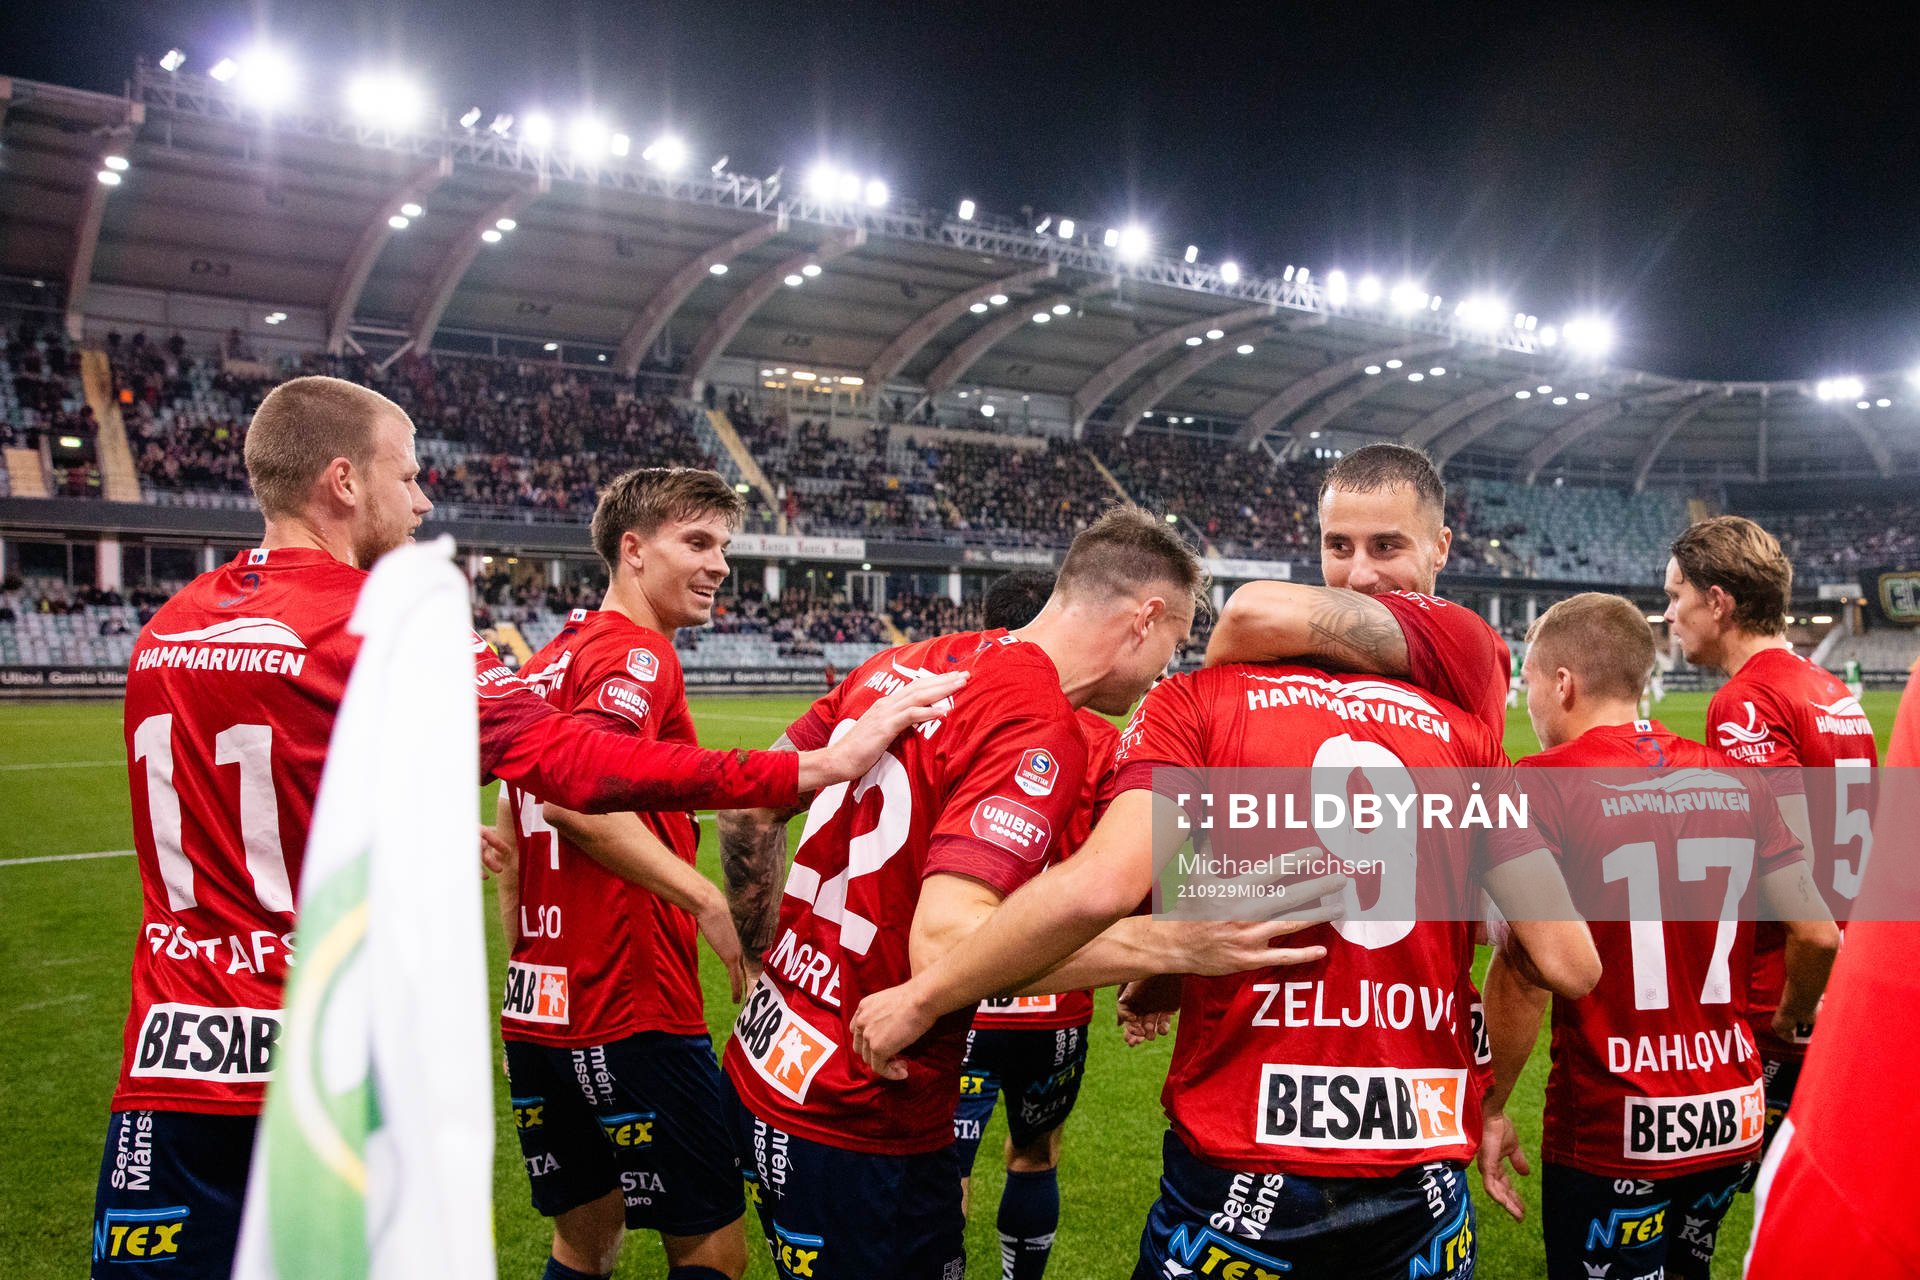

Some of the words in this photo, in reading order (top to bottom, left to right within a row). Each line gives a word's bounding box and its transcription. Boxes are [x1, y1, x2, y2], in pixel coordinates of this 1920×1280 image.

[135, 645, 306, 677] HAMMARVIKEN
[475, 666, 518, 687] UNIB
[1247, 683, 1451, 743] HAMMARVIKEN
[134, 713, 297, 914] 11
[982, 804, 1046, 844] UNIBET
[1601, 791, 1751, 817] HAMMARVIKEN
[1832, 757, 1874, 900] 5
[1310, 733, 1418, 950] 9
[1602, 836, 1757, 1011] 17
[503, 966, 537, 1015] SAB
[736, 978, 783, 1060] SAB
[139, 1011, 283, 1075] BESAB
[571, 1047, 599, 1106] nsson
[1264, 1072, 1420, 1141] BESAB
[111, 1110, 132, 1190] Semr
[127, 1110, 153, 1191] Måns
[753, 1116, 772, 1191] nsson
[1630, 1098, 1738, 1153] BESAB
